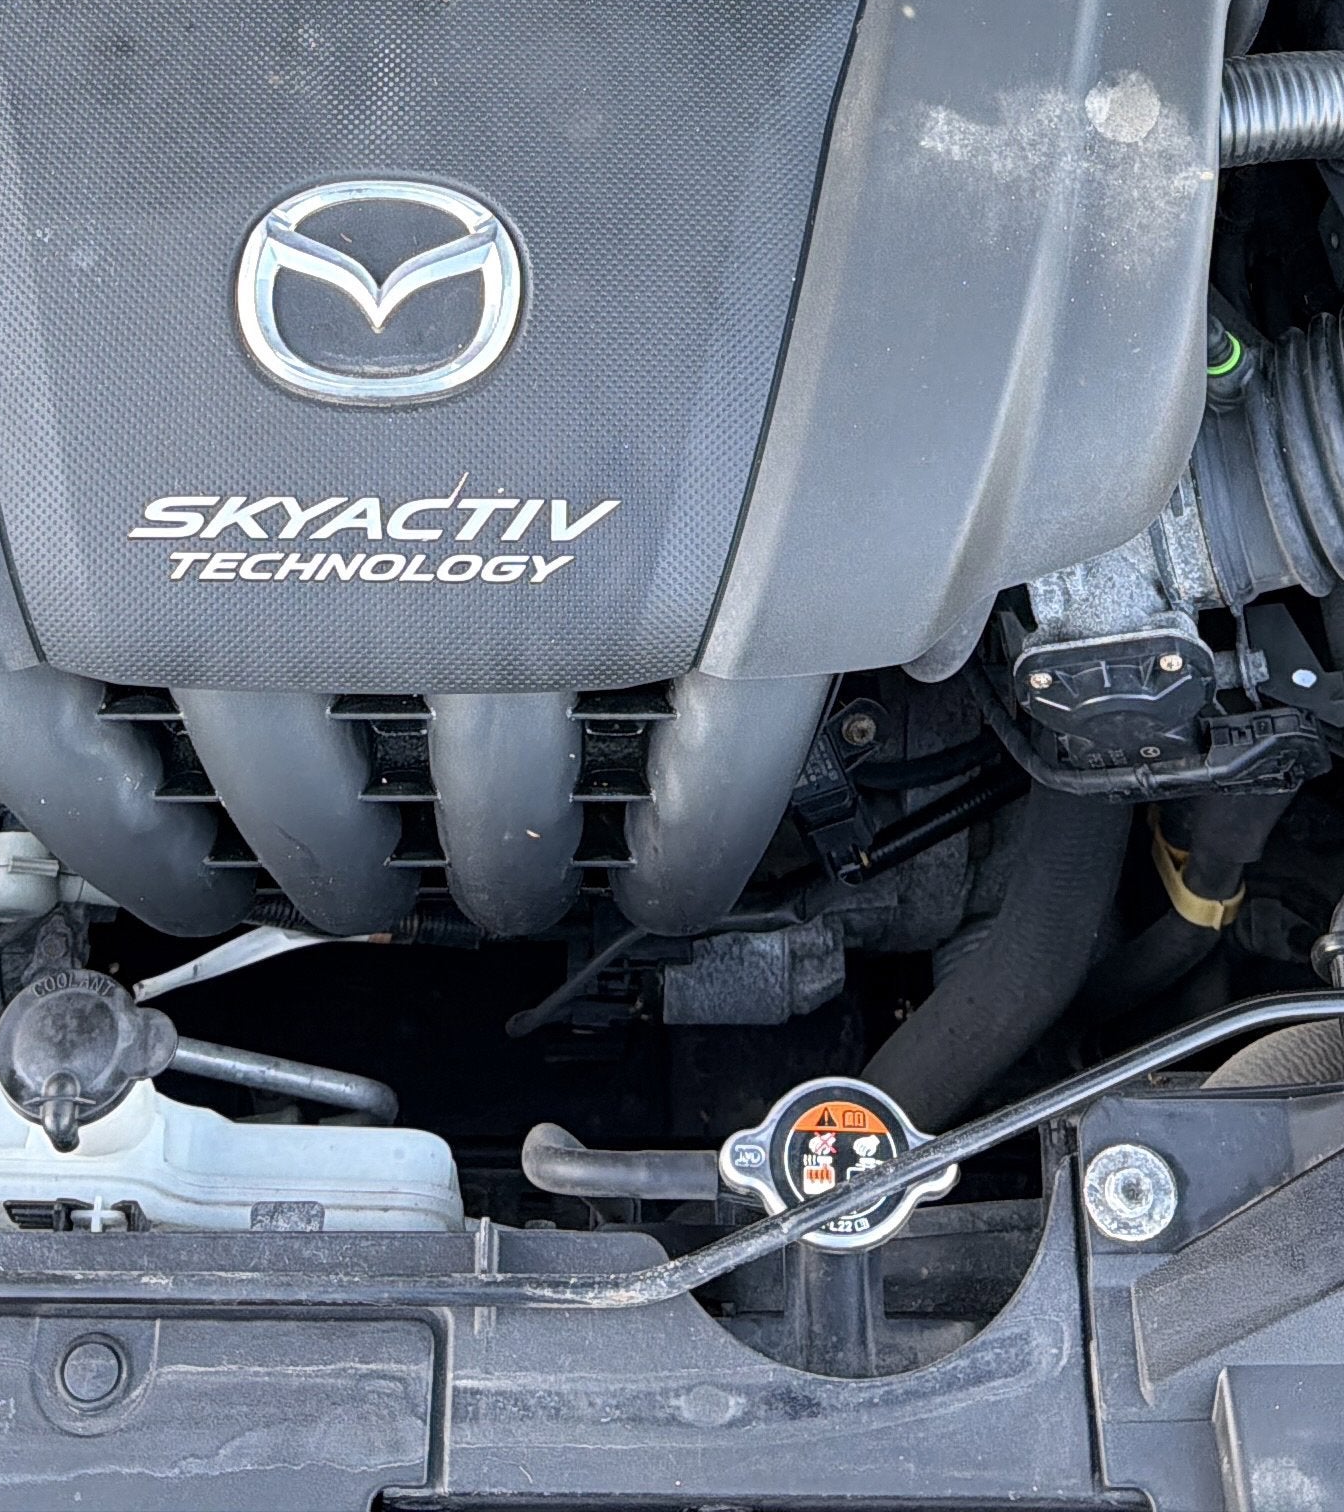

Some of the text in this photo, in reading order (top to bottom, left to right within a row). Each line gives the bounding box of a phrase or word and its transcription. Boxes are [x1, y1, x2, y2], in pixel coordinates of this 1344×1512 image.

[127, 473, 622, 543] SKYACTIV
[168, 550, 575, 583] TECHNOLOGY
[32, 972, 116, 998] COOLANT
[820, 1219, 853, 1233] L22
